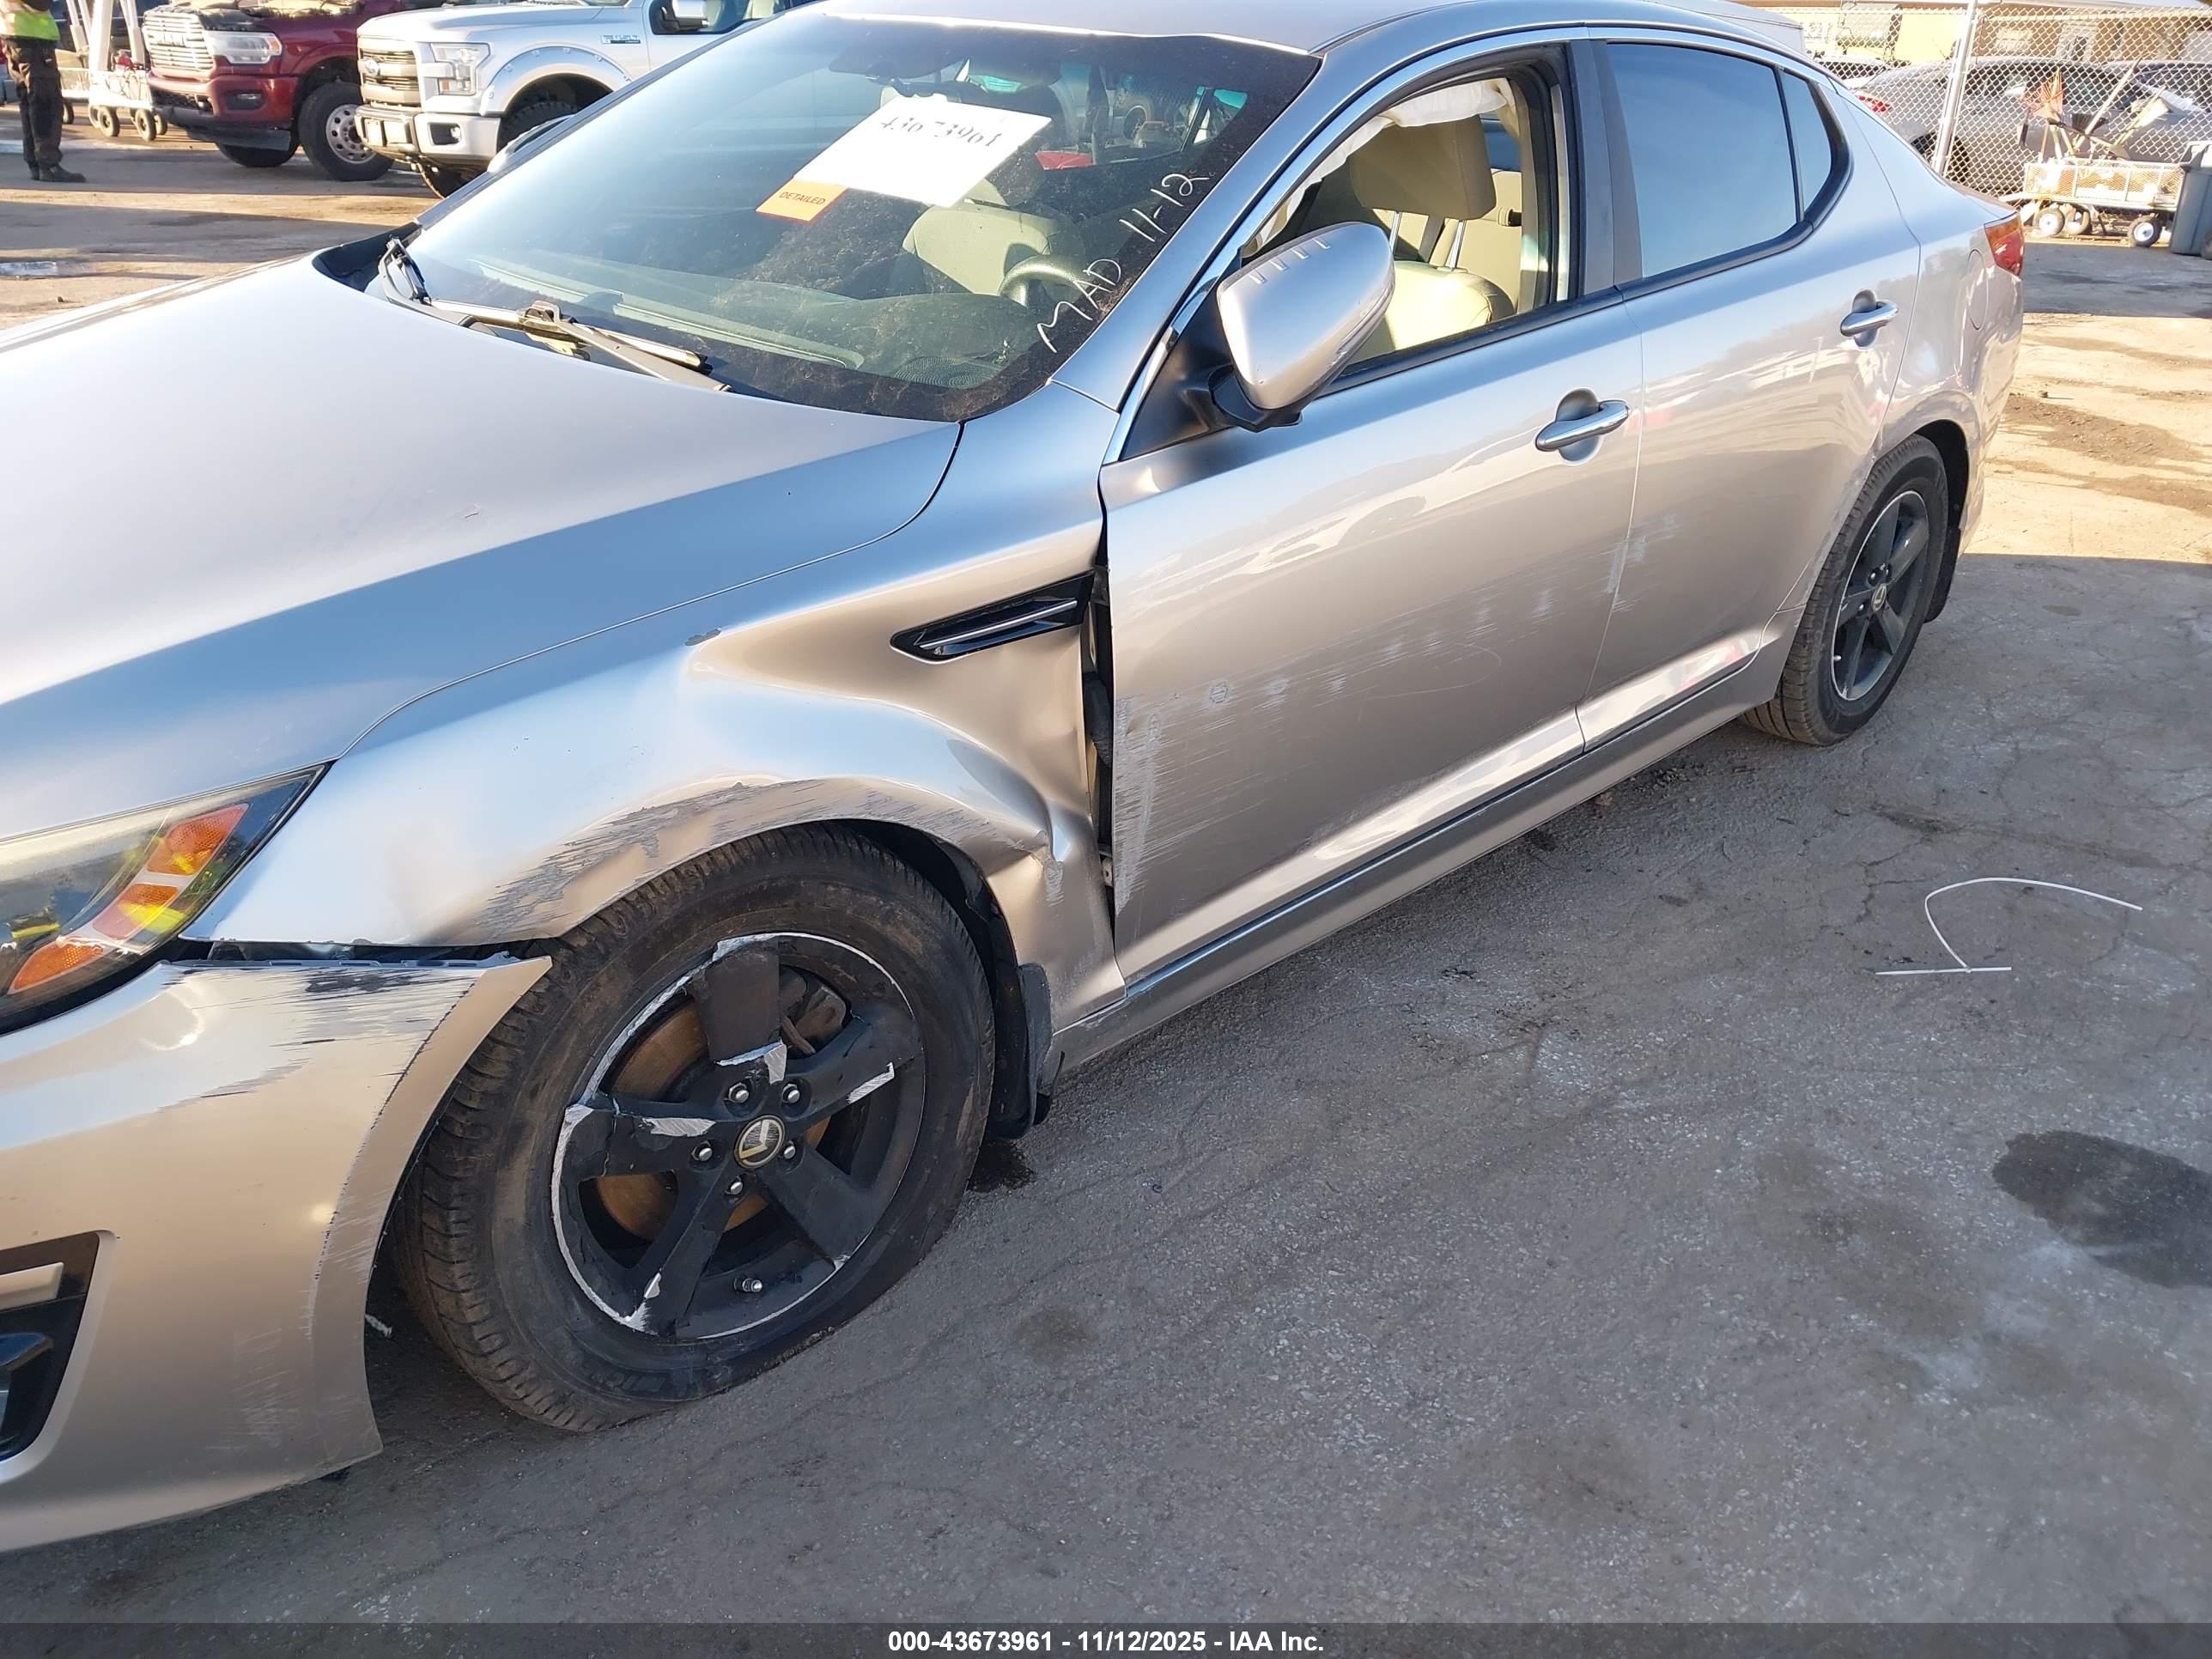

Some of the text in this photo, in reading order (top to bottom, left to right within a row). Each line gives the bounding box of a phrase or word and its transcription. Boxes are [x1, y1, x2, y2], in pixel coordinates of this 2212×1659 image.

[778, 191, 827, 205] DETAILED
[1036, 173, 1210, 353] MAD 11-12
